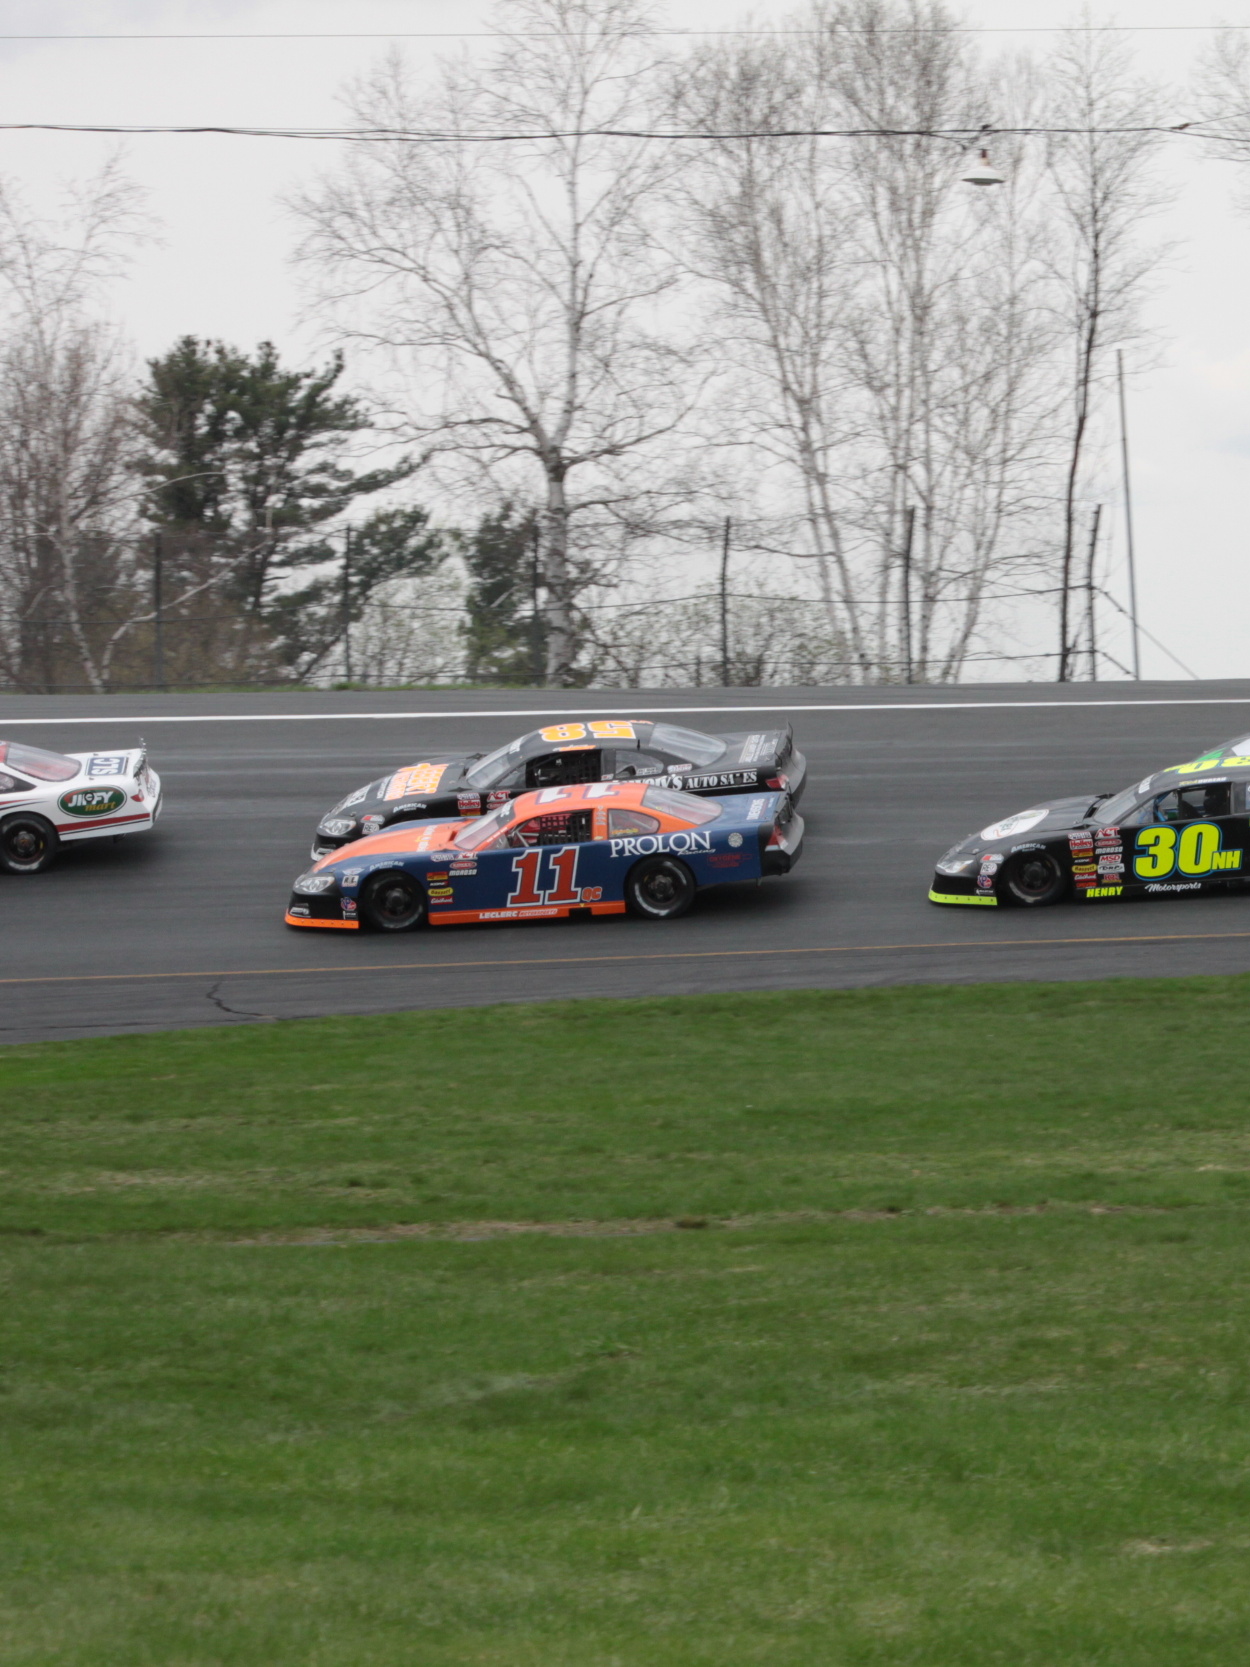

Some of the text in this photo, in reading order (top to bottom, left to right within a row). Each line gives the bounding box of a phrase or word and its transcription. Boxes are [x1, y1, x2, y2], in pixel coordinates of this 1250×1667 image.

[91, 758, 121, 775] SLC
[685, 776, 718, 789] AUTO
[720, 772, 757, 785] SAES
[68, 791, 114, 807] JIFY
[486, 790, 511, 802] ACT
[85, 801, 116, 812] mart
[1095, 827, 1120, 838] ACT
[609, 831, 711, 858] PROLON
[1011, 843, 1046, 853] AMERICAN
[1134, 822, 1243, 880] 30 NH
[507, 846, 602, 907] 11 QC
[1086, 886, 1123, 898] HENRY
[1145, 882, 1202, 892] Motorsports
[479, 911, 518, 919] LECLERC
